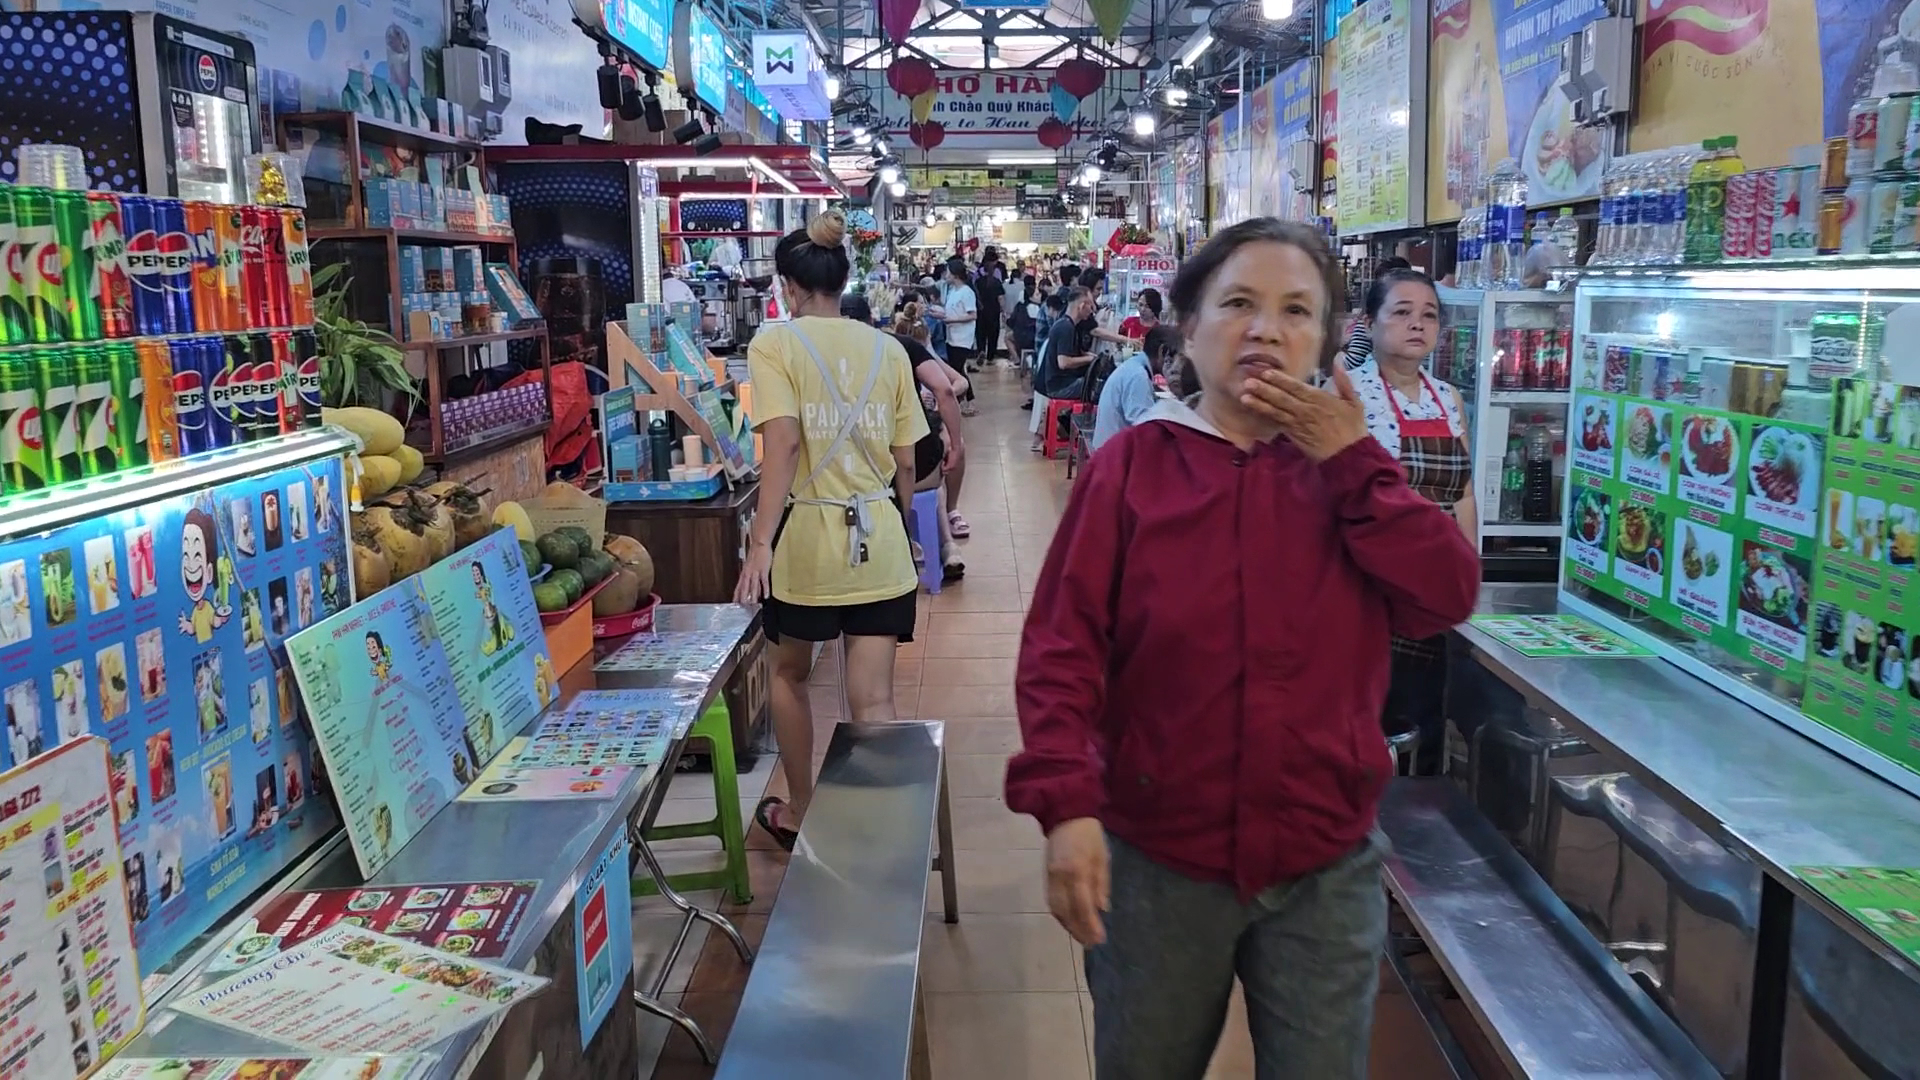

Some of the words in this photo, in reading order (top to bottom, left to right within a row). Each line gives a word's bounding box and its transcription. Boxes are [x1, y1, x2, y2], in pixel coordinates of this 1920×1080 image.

[200, 68, 216, 79] PEPSI
[934, 73, 981, 98] HỢ
[949, 100, 982, 113] Chào
[957, 118, 976, 129] to
[985, 116, 1032, 129] Han
